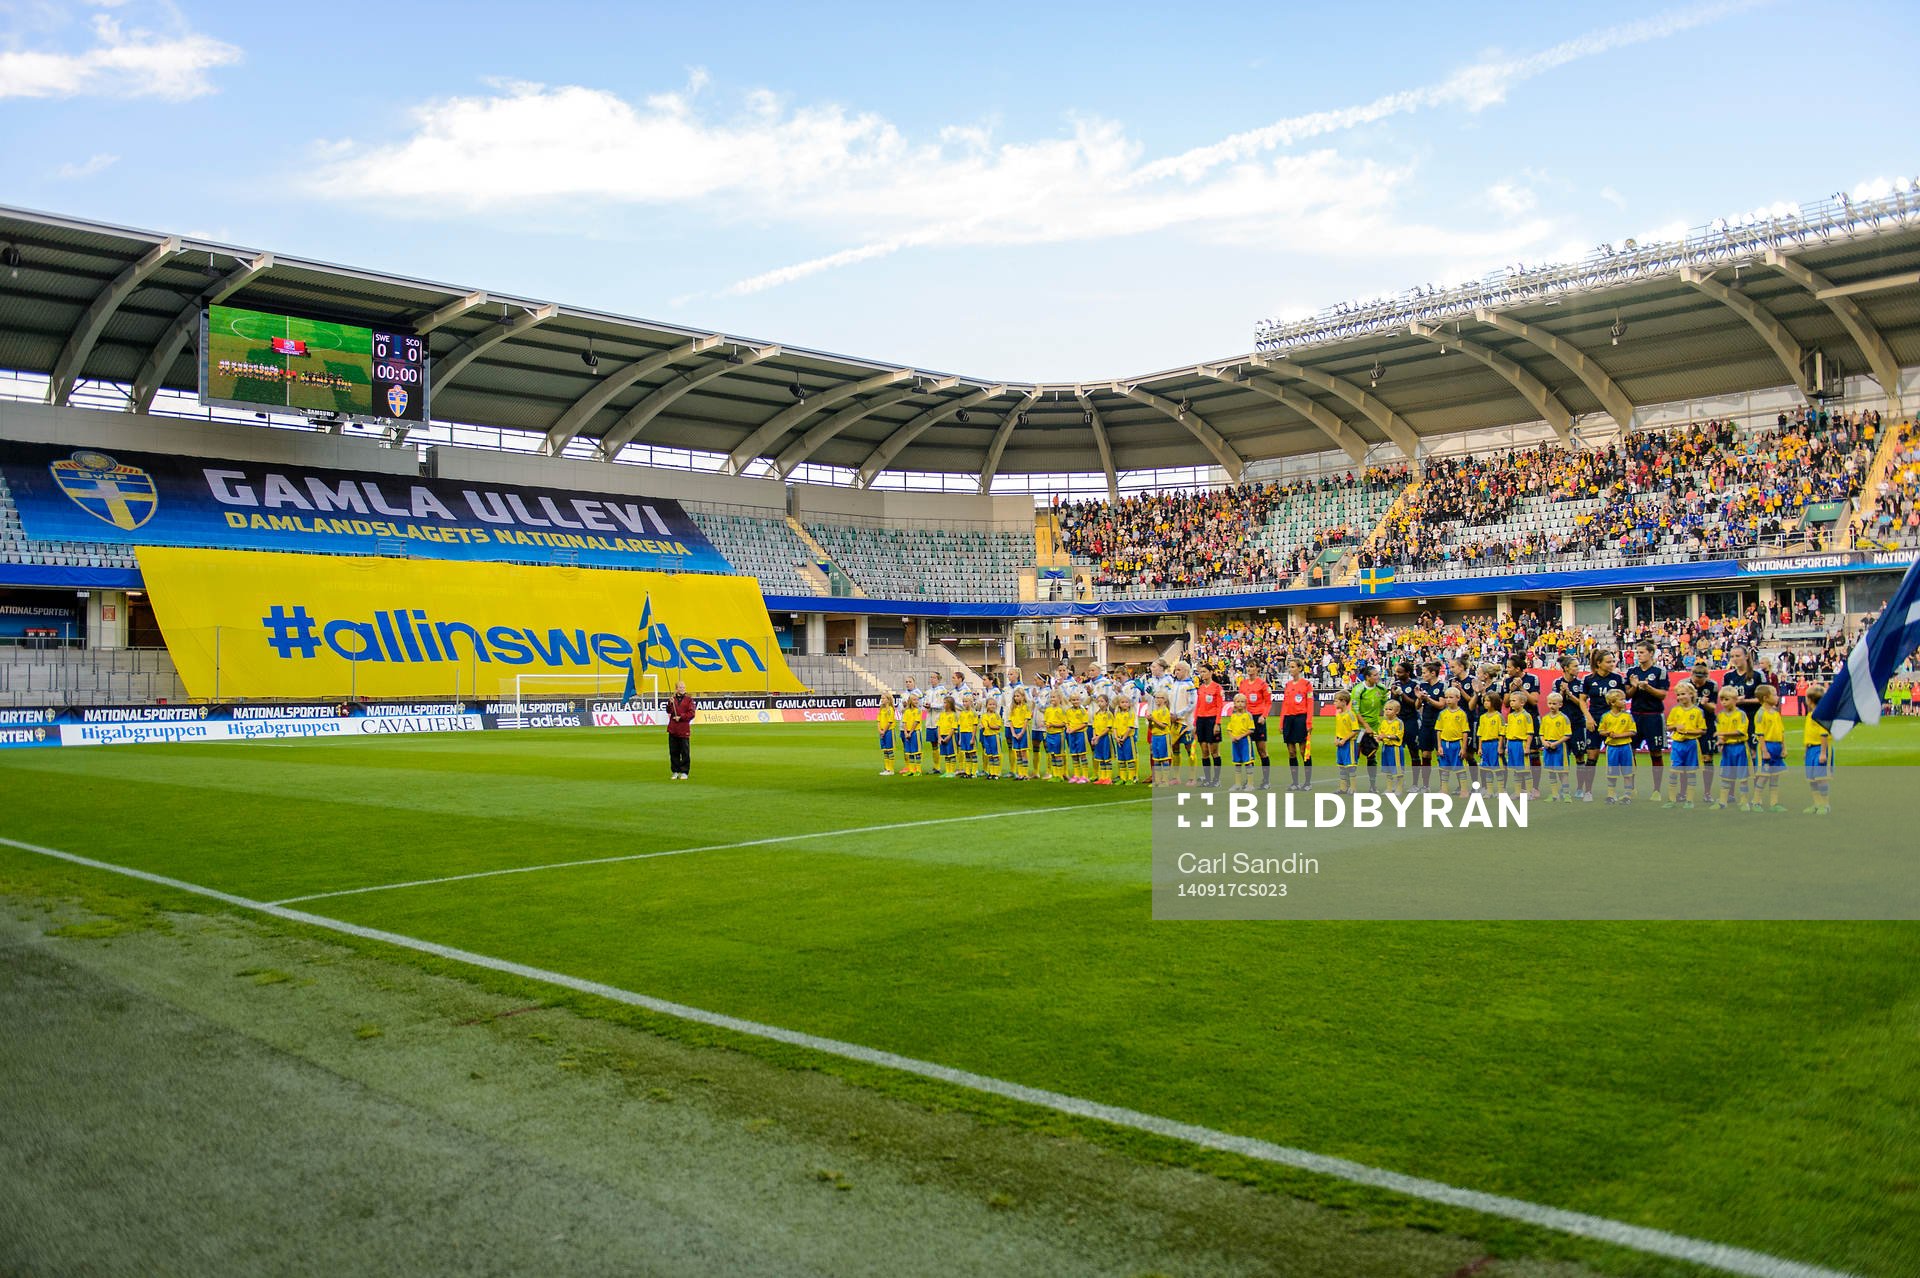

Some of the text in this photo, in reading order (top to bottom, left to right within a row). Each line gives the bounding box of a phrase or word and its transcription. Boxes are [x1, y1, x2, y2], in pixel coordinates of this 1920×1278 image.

[375, 333, 420, 347] SWE SCO
[377, 343, 387, 358] 0
[408, 348, 418, 362] 0
[377, 364, 418, 383] 00:00
[203, 469, 671, 536] GAMLA ULLEVI
[224, 511, 693, 556] DAMLANDSLAGETS NATIONALARENA
[1874, 550, 1919, 564] NATIONA
[1747, 556, 1841, 572] NATIONALSPORTEN
[0, 605, 69, 617] ATIONALSPORTEN
[262, 606, 767, 672] #allinsweden
[486, 703, 568, 714] NATIONALSPORTEN
[592, 702, 631, 712] GAMLA
[693, 700, 766, 710] AMLA ULLEVI
[775, 699, 846, 708] GAMLA ULLEVI
[855, 698, 882, 707] GAML
[84, 708, 198, 722] NATIONALSPORTEN
[233, 706, 335, 719] NATIONALSPORTEN
[366, 704, 457, 716] NATIONALSPORTEN
[804, 711, 846, 721] Scandic
[361, 716, 475, 733] CAVALIERE
[531, 714, 580, 727] adidas
[596, 714, 620, 726] ICA
[632, 713, 656, 725] ICA
[81, 725, 207, 743] Higabgruppen
[228, 721, 340, 738] Higabgruppen
